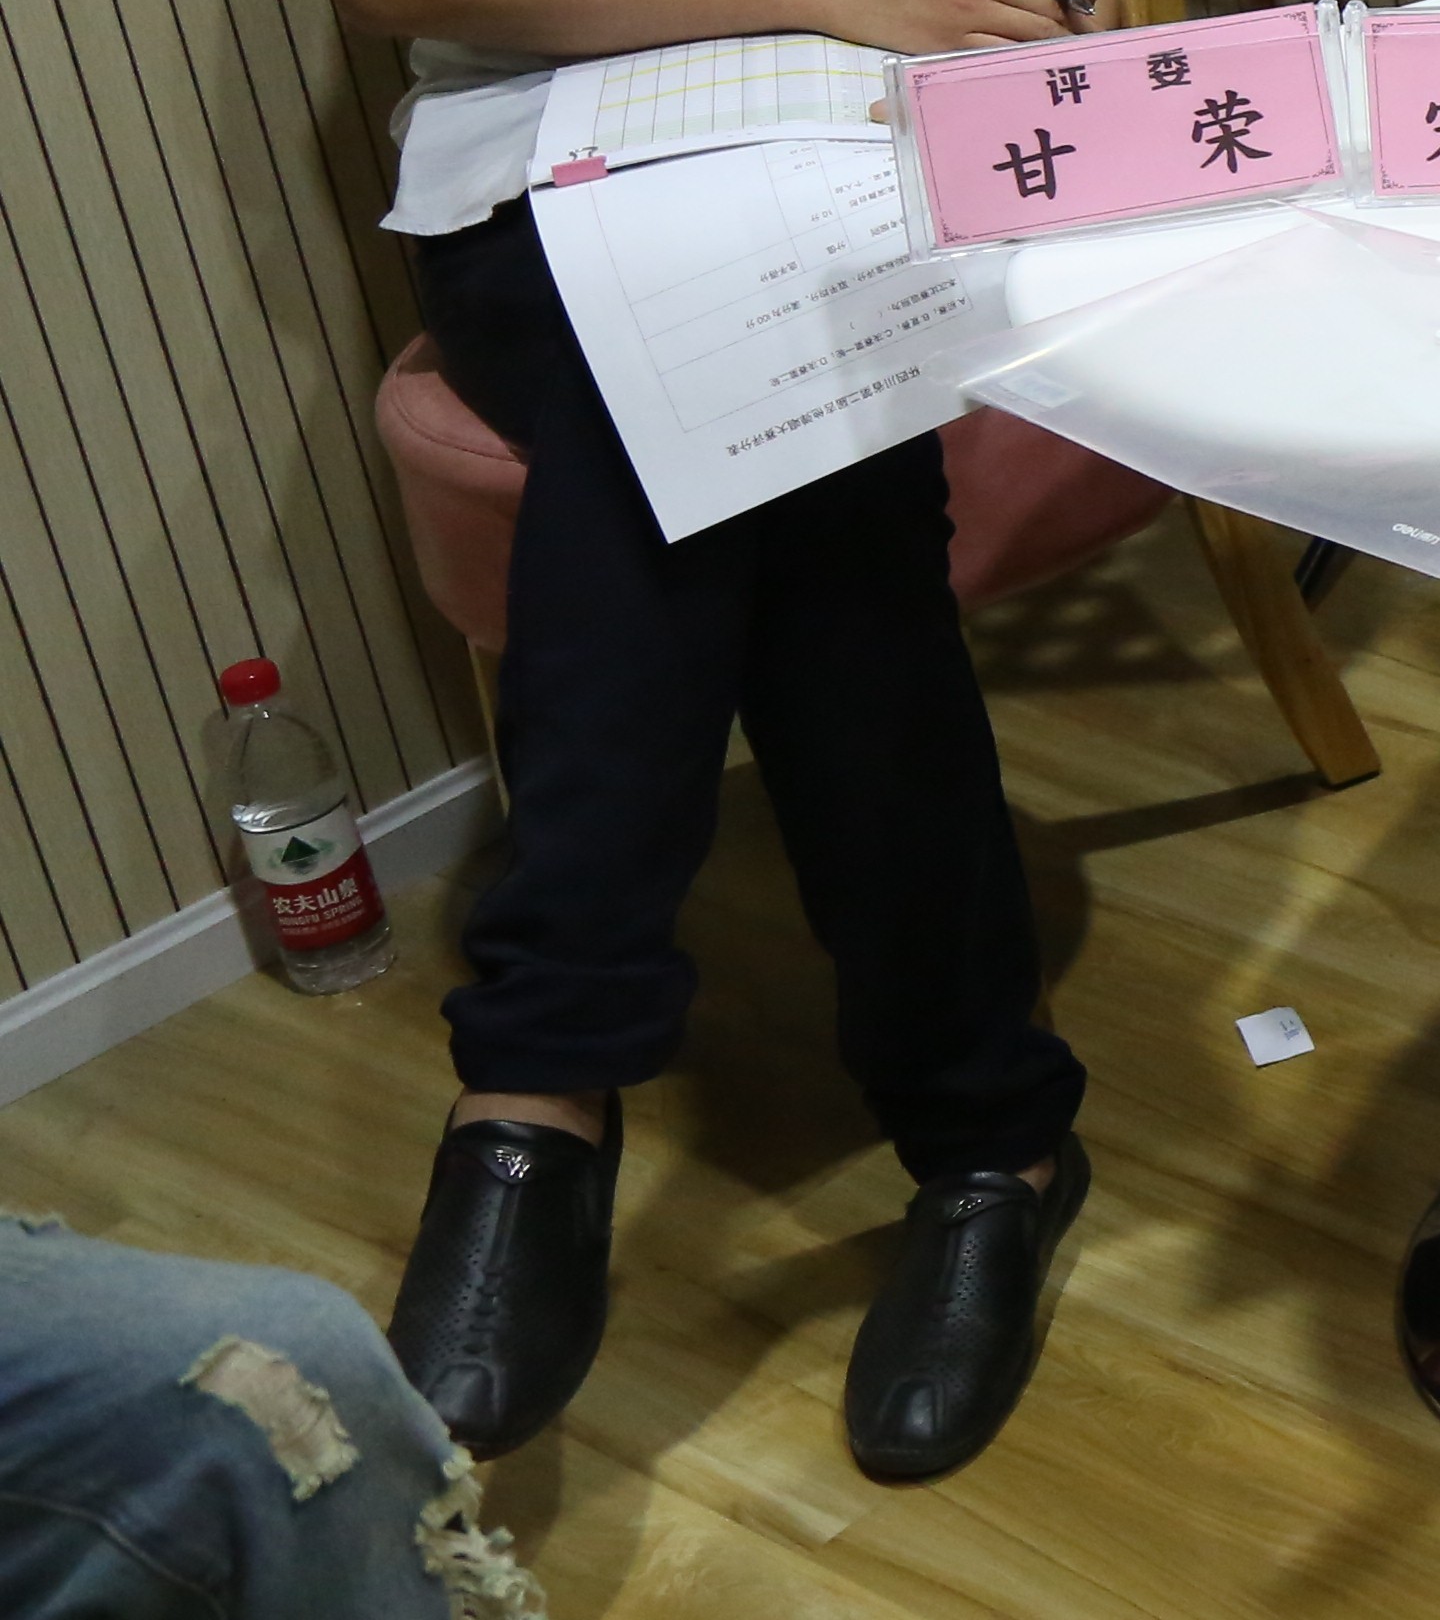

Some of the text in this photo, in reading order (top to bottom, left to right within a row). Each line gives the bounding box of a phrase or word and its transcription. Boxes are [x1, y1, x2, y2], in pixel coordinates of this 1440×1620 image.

[1046, 47, 1192, 107] 评委
[993, 89, 1273, 200] 甘荣
[272, 876, 359, 915] 农夫山泉
